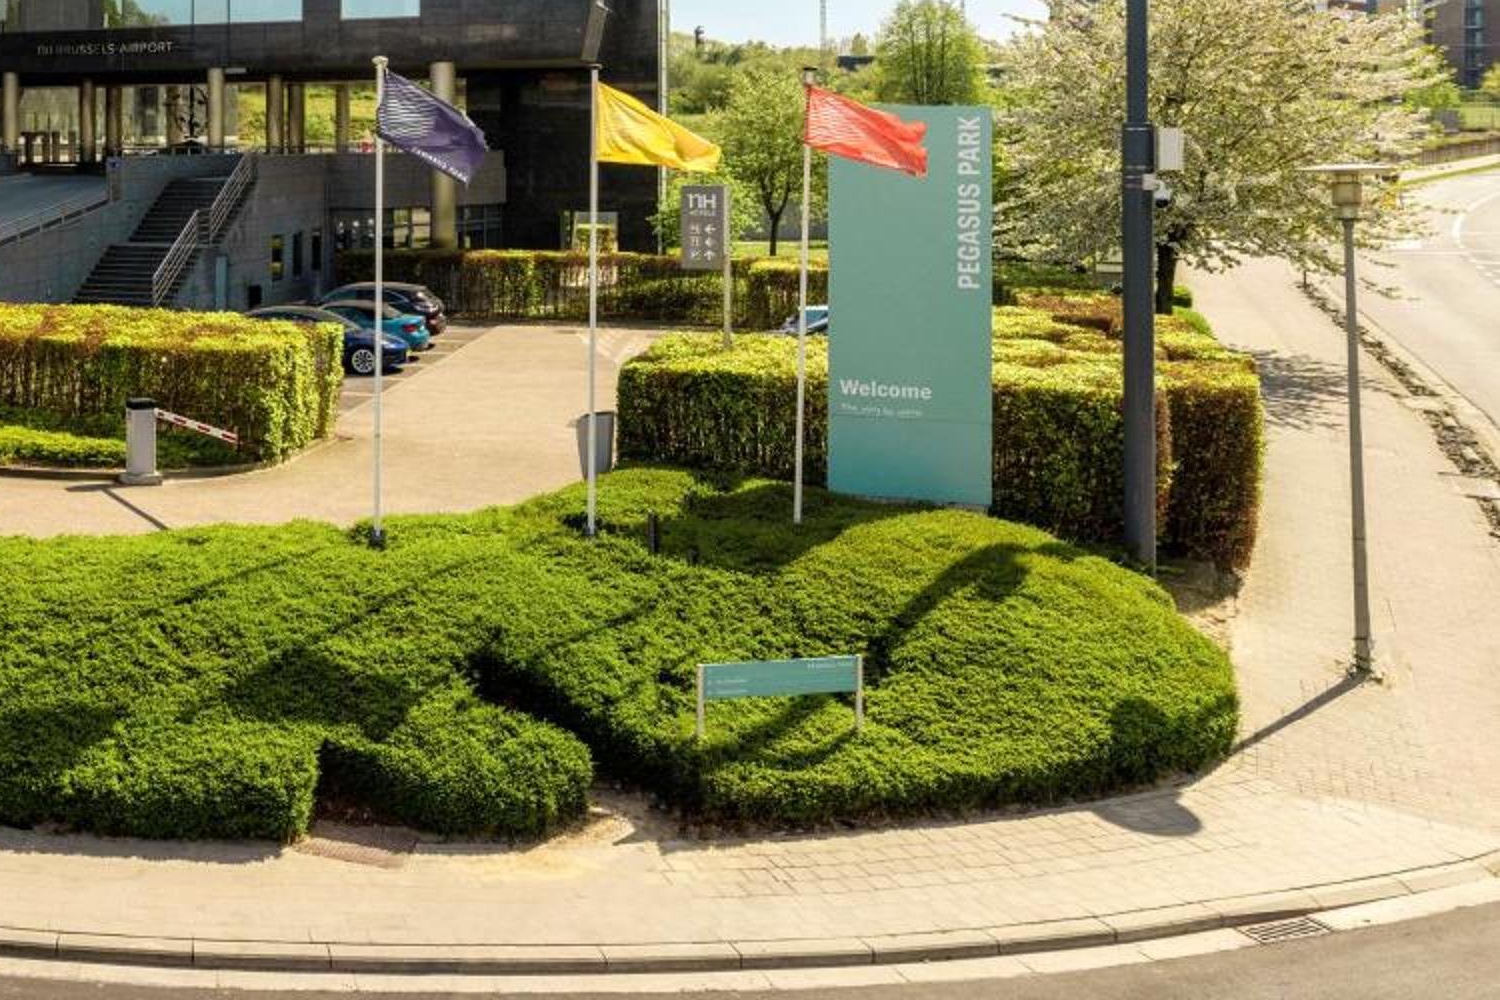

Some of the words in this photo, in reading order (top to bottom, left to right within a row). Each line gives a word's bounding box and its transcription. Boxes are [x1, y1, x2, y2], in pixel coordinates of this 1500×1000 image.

[957, 116, 981, 175] PARK
[957, 183, 981, 289] PEGASUS
[839, 379, 932, 399] Welcome
